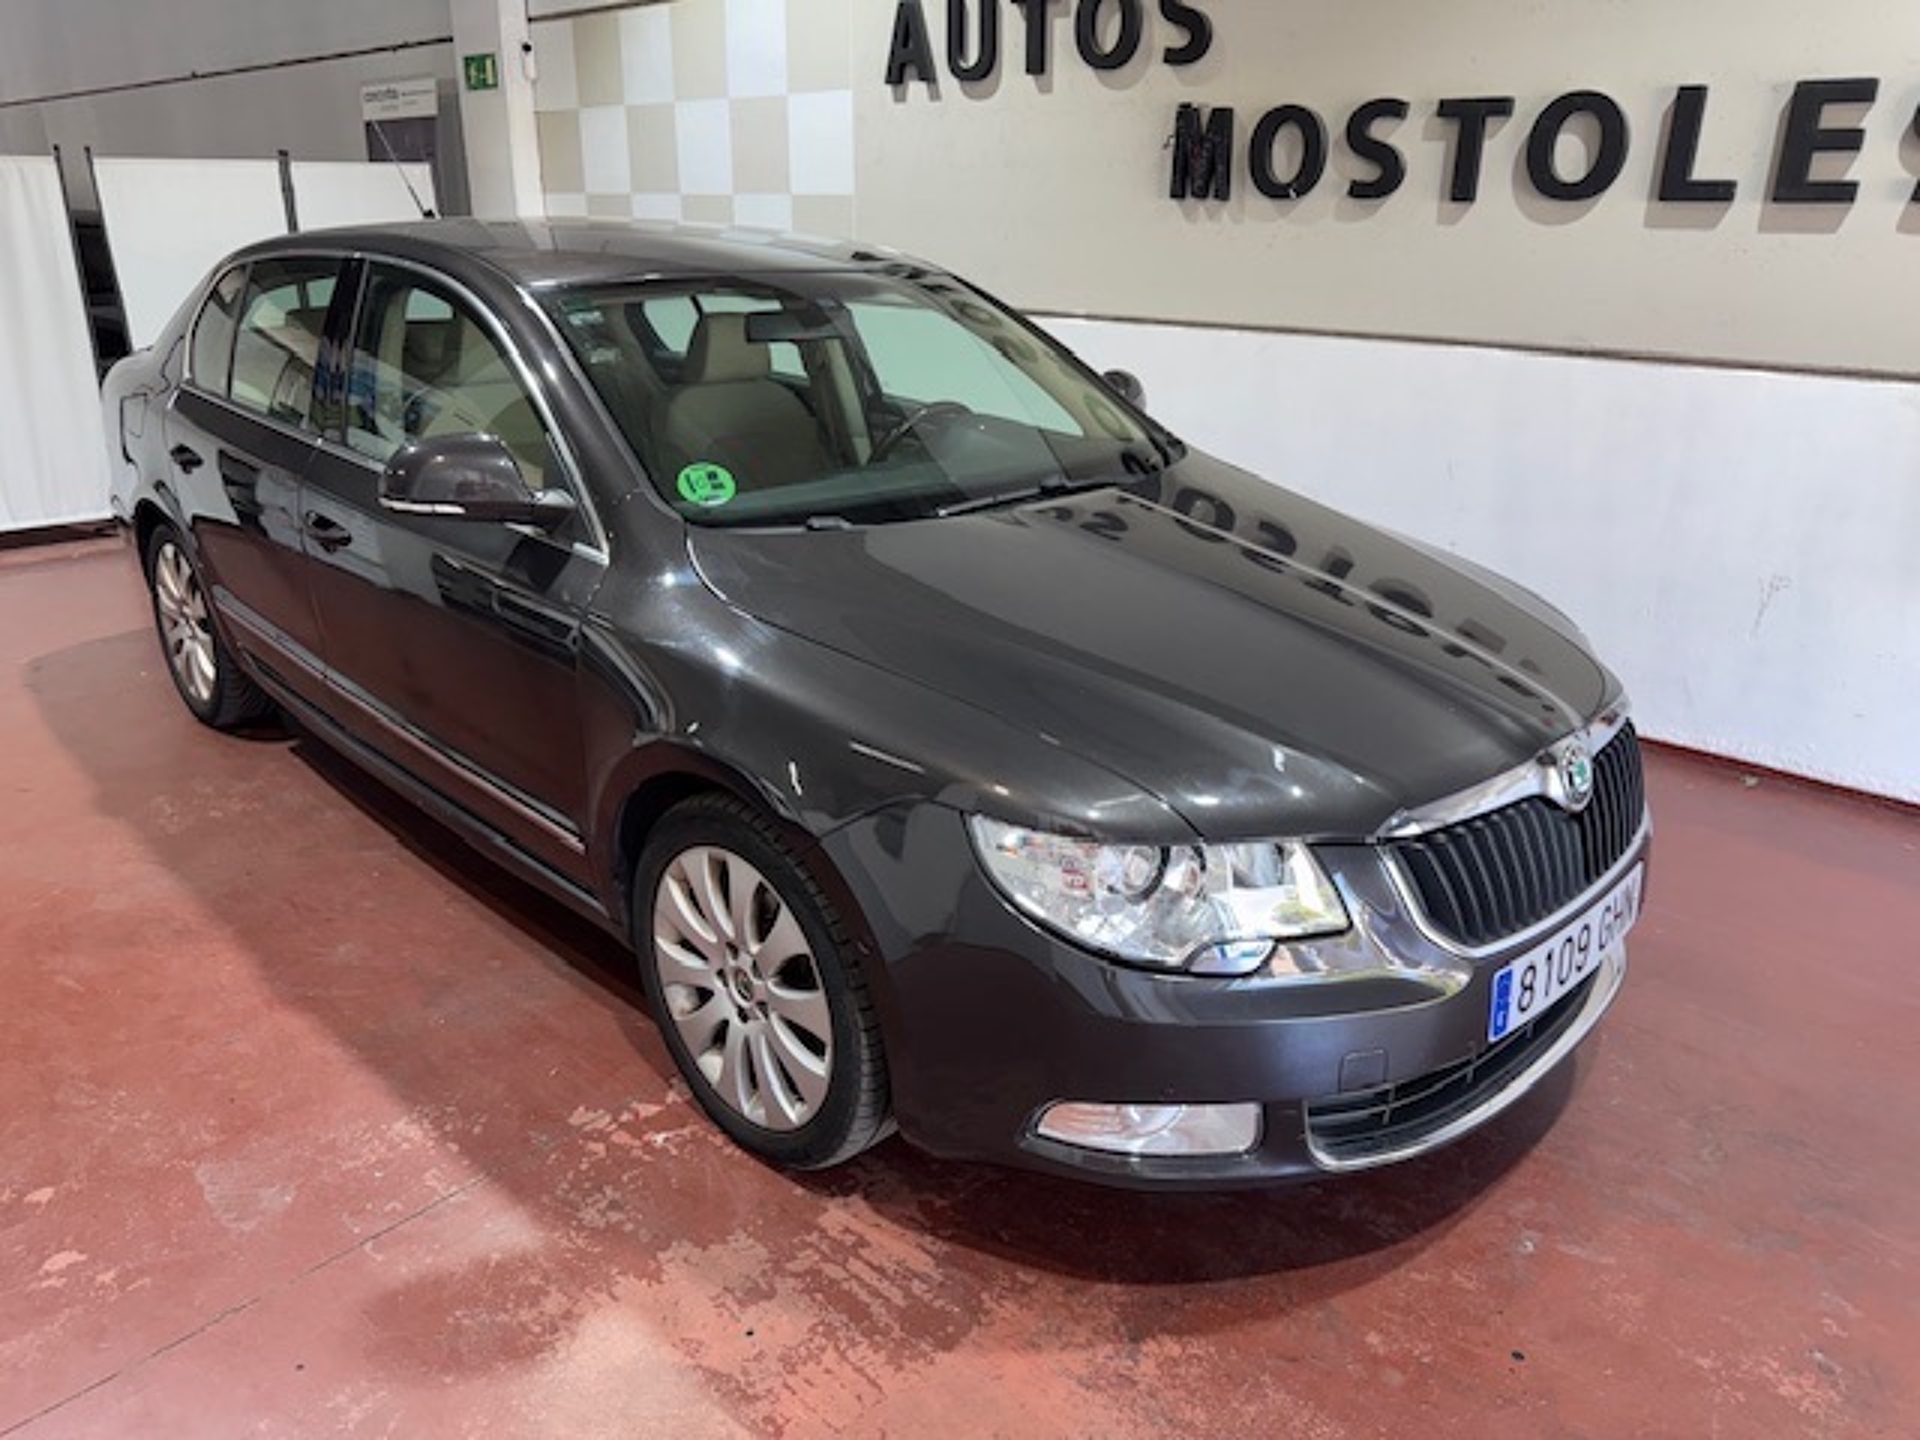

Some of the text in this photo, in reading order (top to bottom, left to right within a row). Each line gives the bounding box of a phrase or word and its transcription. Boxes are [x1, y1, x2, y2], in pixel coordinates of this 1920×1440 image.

[885, 0, 1213, 84] AUTOS
[1168, 77, 1920, 203] MOSTOLE
[1516, 923, 1591, 1013] 8109
